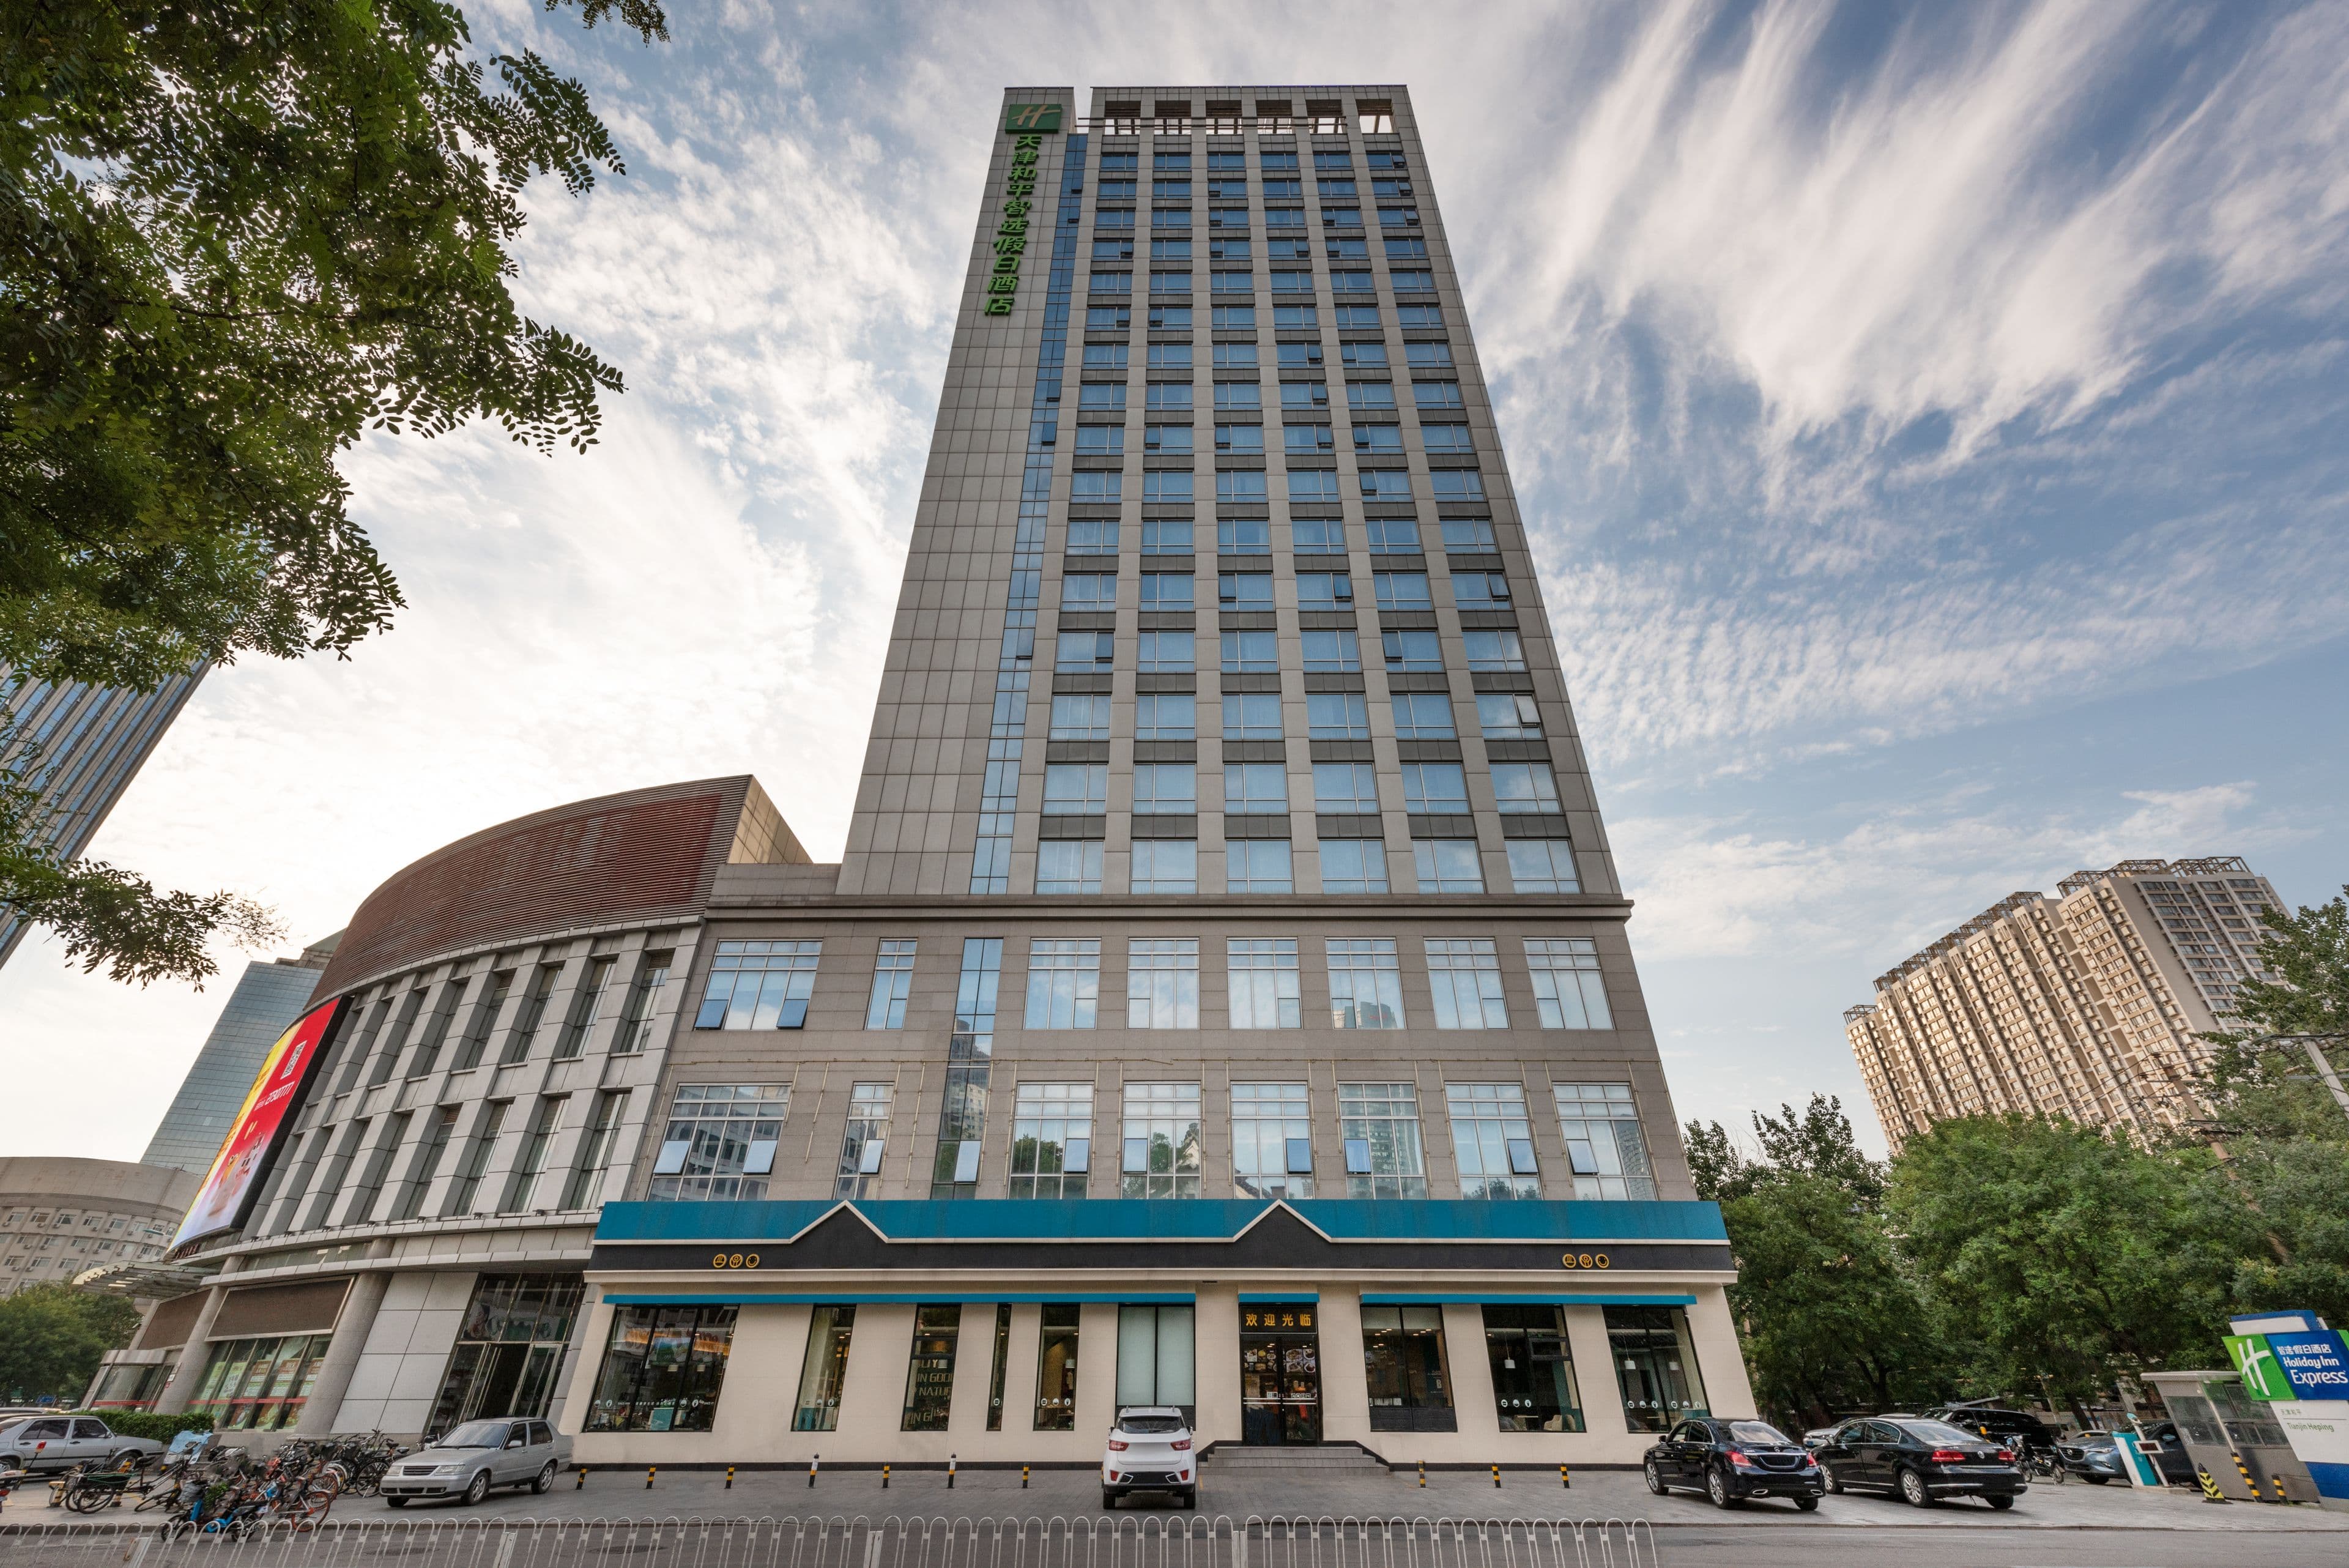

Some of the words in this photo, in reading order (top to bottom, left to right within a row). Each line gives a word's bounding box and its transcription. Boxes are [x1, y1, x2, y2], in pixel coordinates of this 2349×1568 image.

[984, 134, 1042, 316] 天津和平智选假日酒店
[1245, 1313, 1311, 1326] 欢迎光临
[2277, 1343, 2332, 1355] 智选假日酒店
[2283, 1356, 2321, 1369] Holiday
[2320, 1355, 2340, 1366] Inn
[2290, 1370, 2348, 1388] Express
[2307, 1423, 2334, 1432] Heping
